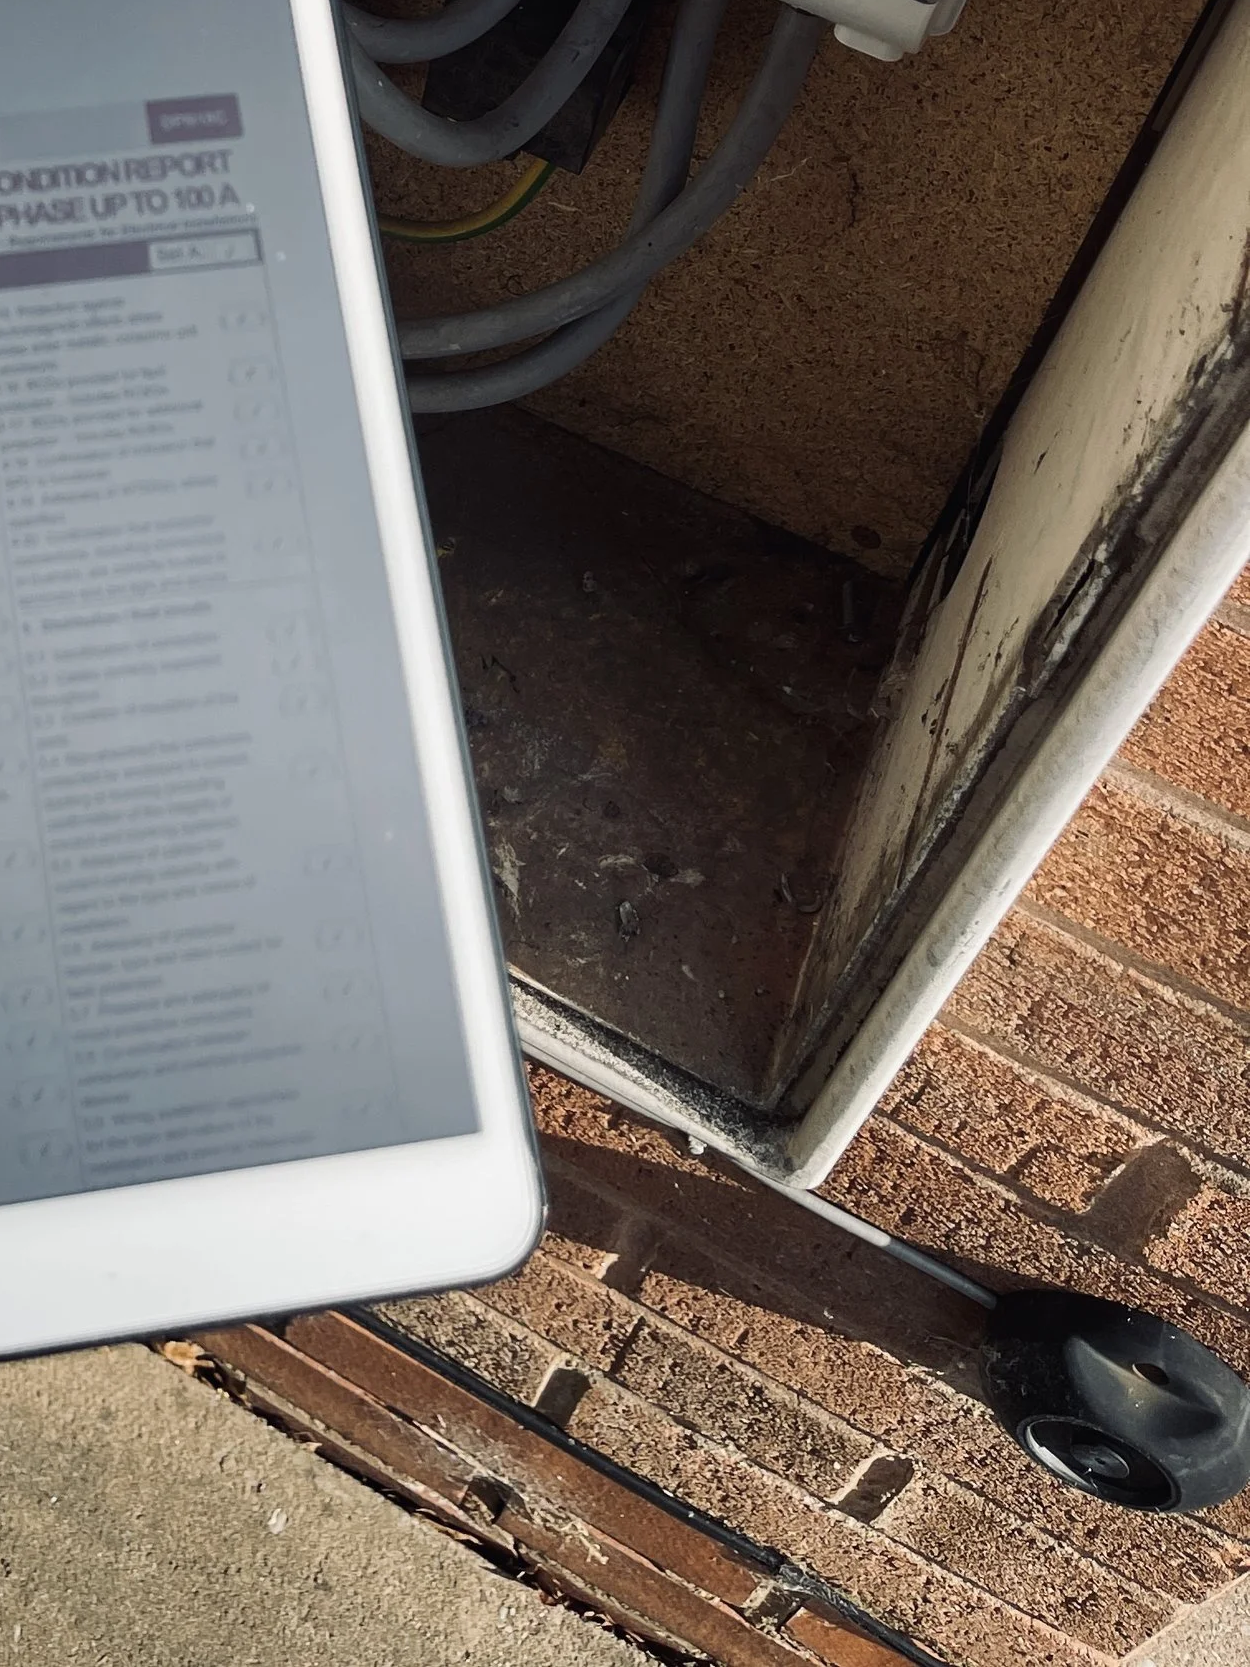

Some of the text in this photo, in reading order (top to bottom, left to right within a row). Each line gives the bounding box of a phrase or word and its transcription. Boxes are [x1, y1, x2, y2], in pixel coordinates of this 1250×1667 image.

[123, 148, 234, 183] REPORT
[89, 192, 128, 222] UP
[130, 188, 170, 216] TO
[173, 184, 216, 212] 100
[217, 181, 240, 208] A
